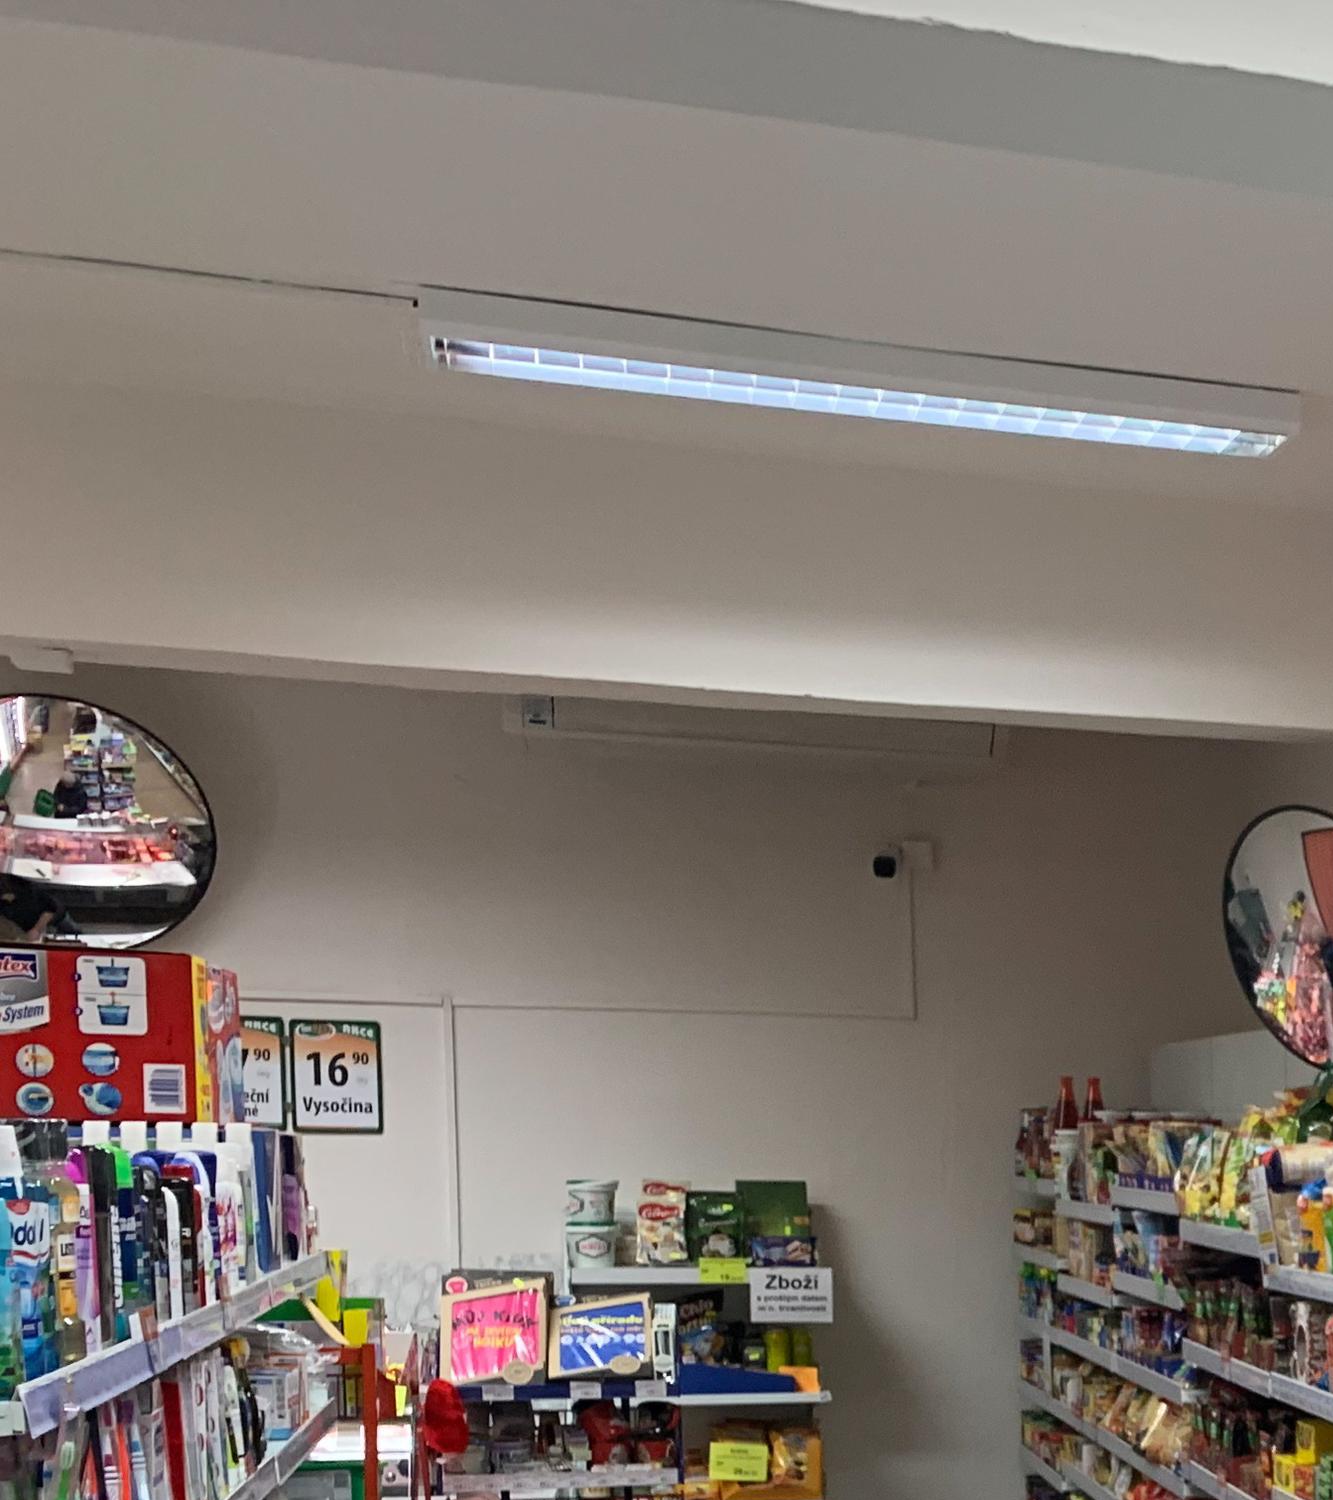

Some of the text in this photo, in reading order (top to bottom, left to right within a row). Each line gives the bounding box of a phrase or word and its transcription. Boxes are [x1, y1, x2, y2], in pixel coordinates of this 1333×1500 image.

[4, 1002, 45, 1024] System
[253, 1047, 271, 1062] 90
[305, 1050, 370, 1087] 16 90
[243, 1088, 270, 1104] eční
[302, 1096, 374, 1117] Vysočina
[764, 1273, 820, 1291] Zboží
